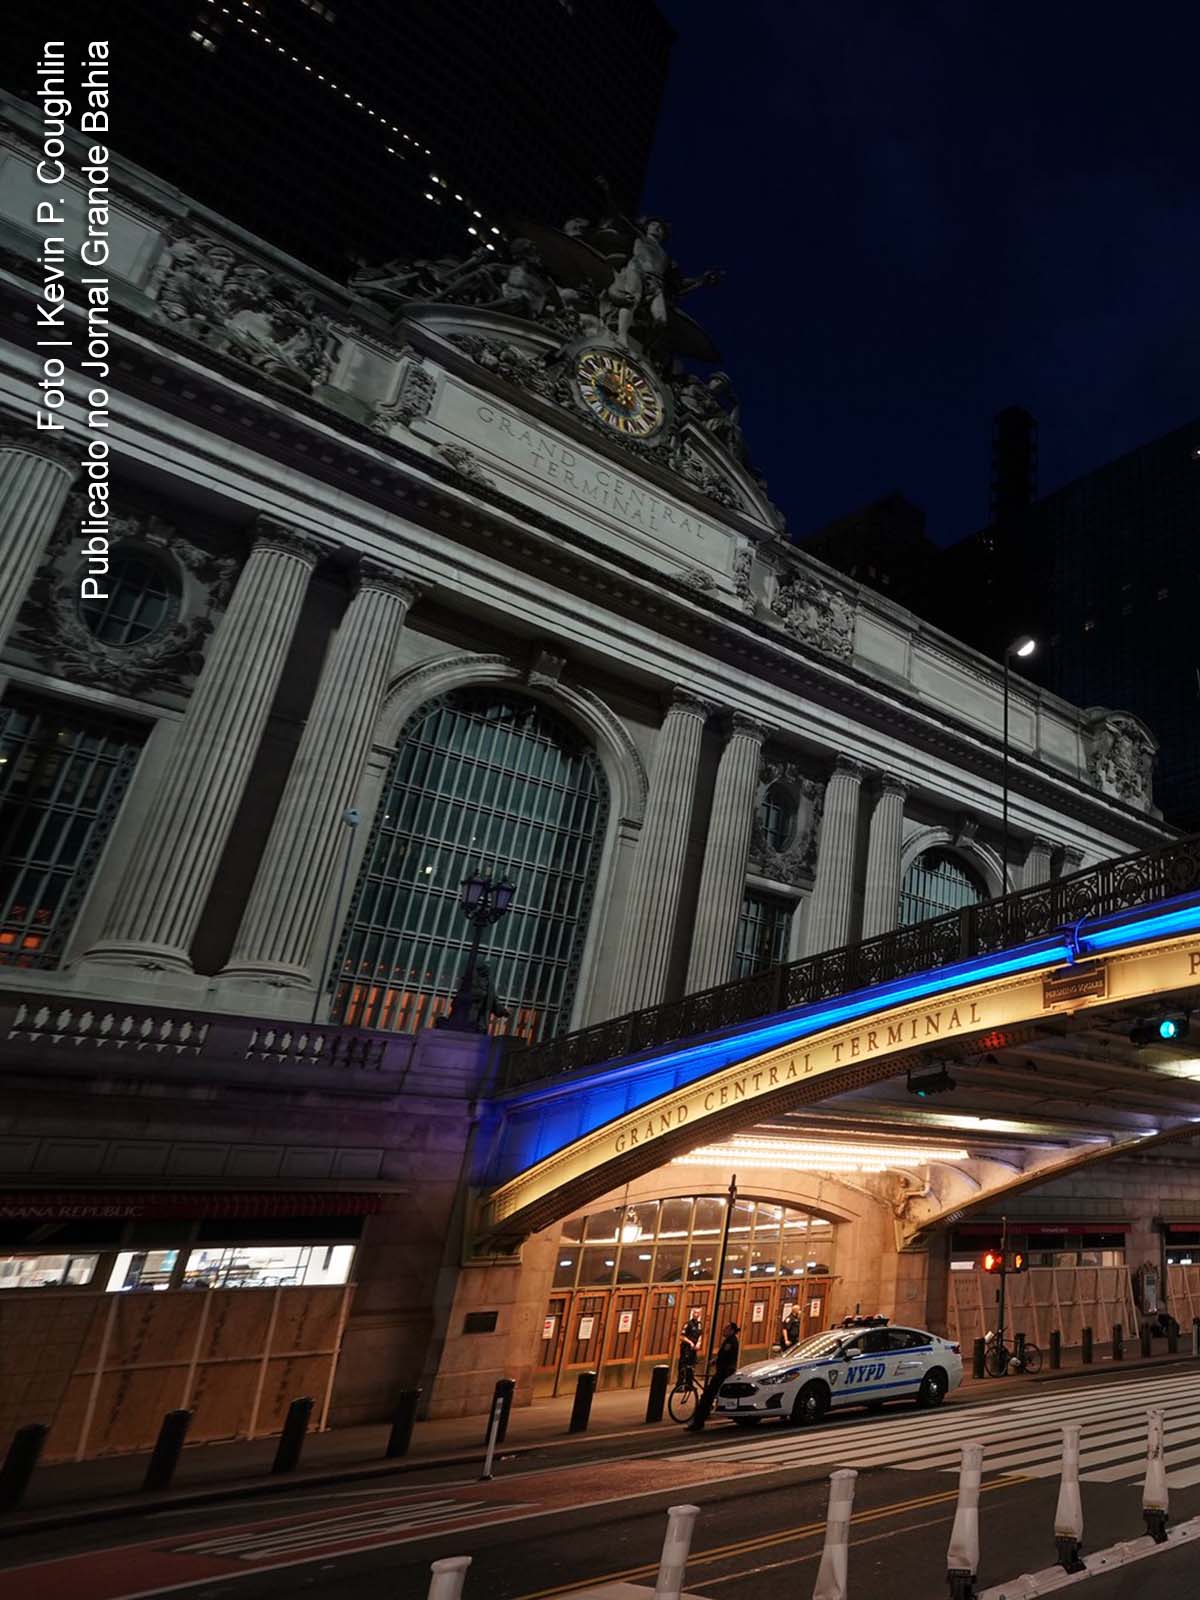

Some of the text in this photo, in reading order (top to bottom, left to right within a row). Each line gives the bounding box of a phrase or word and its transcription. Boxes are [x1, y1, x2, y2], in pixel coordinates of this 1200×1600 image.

[476, 406, 705, 541] GRAND CENTRAL
[530, 452, 659, 533] TERMINAL
[614, 1002, 983, 1153] GRAND CENTRAL TERMINAL
[844, 1362, 886, 1385] NYPD
